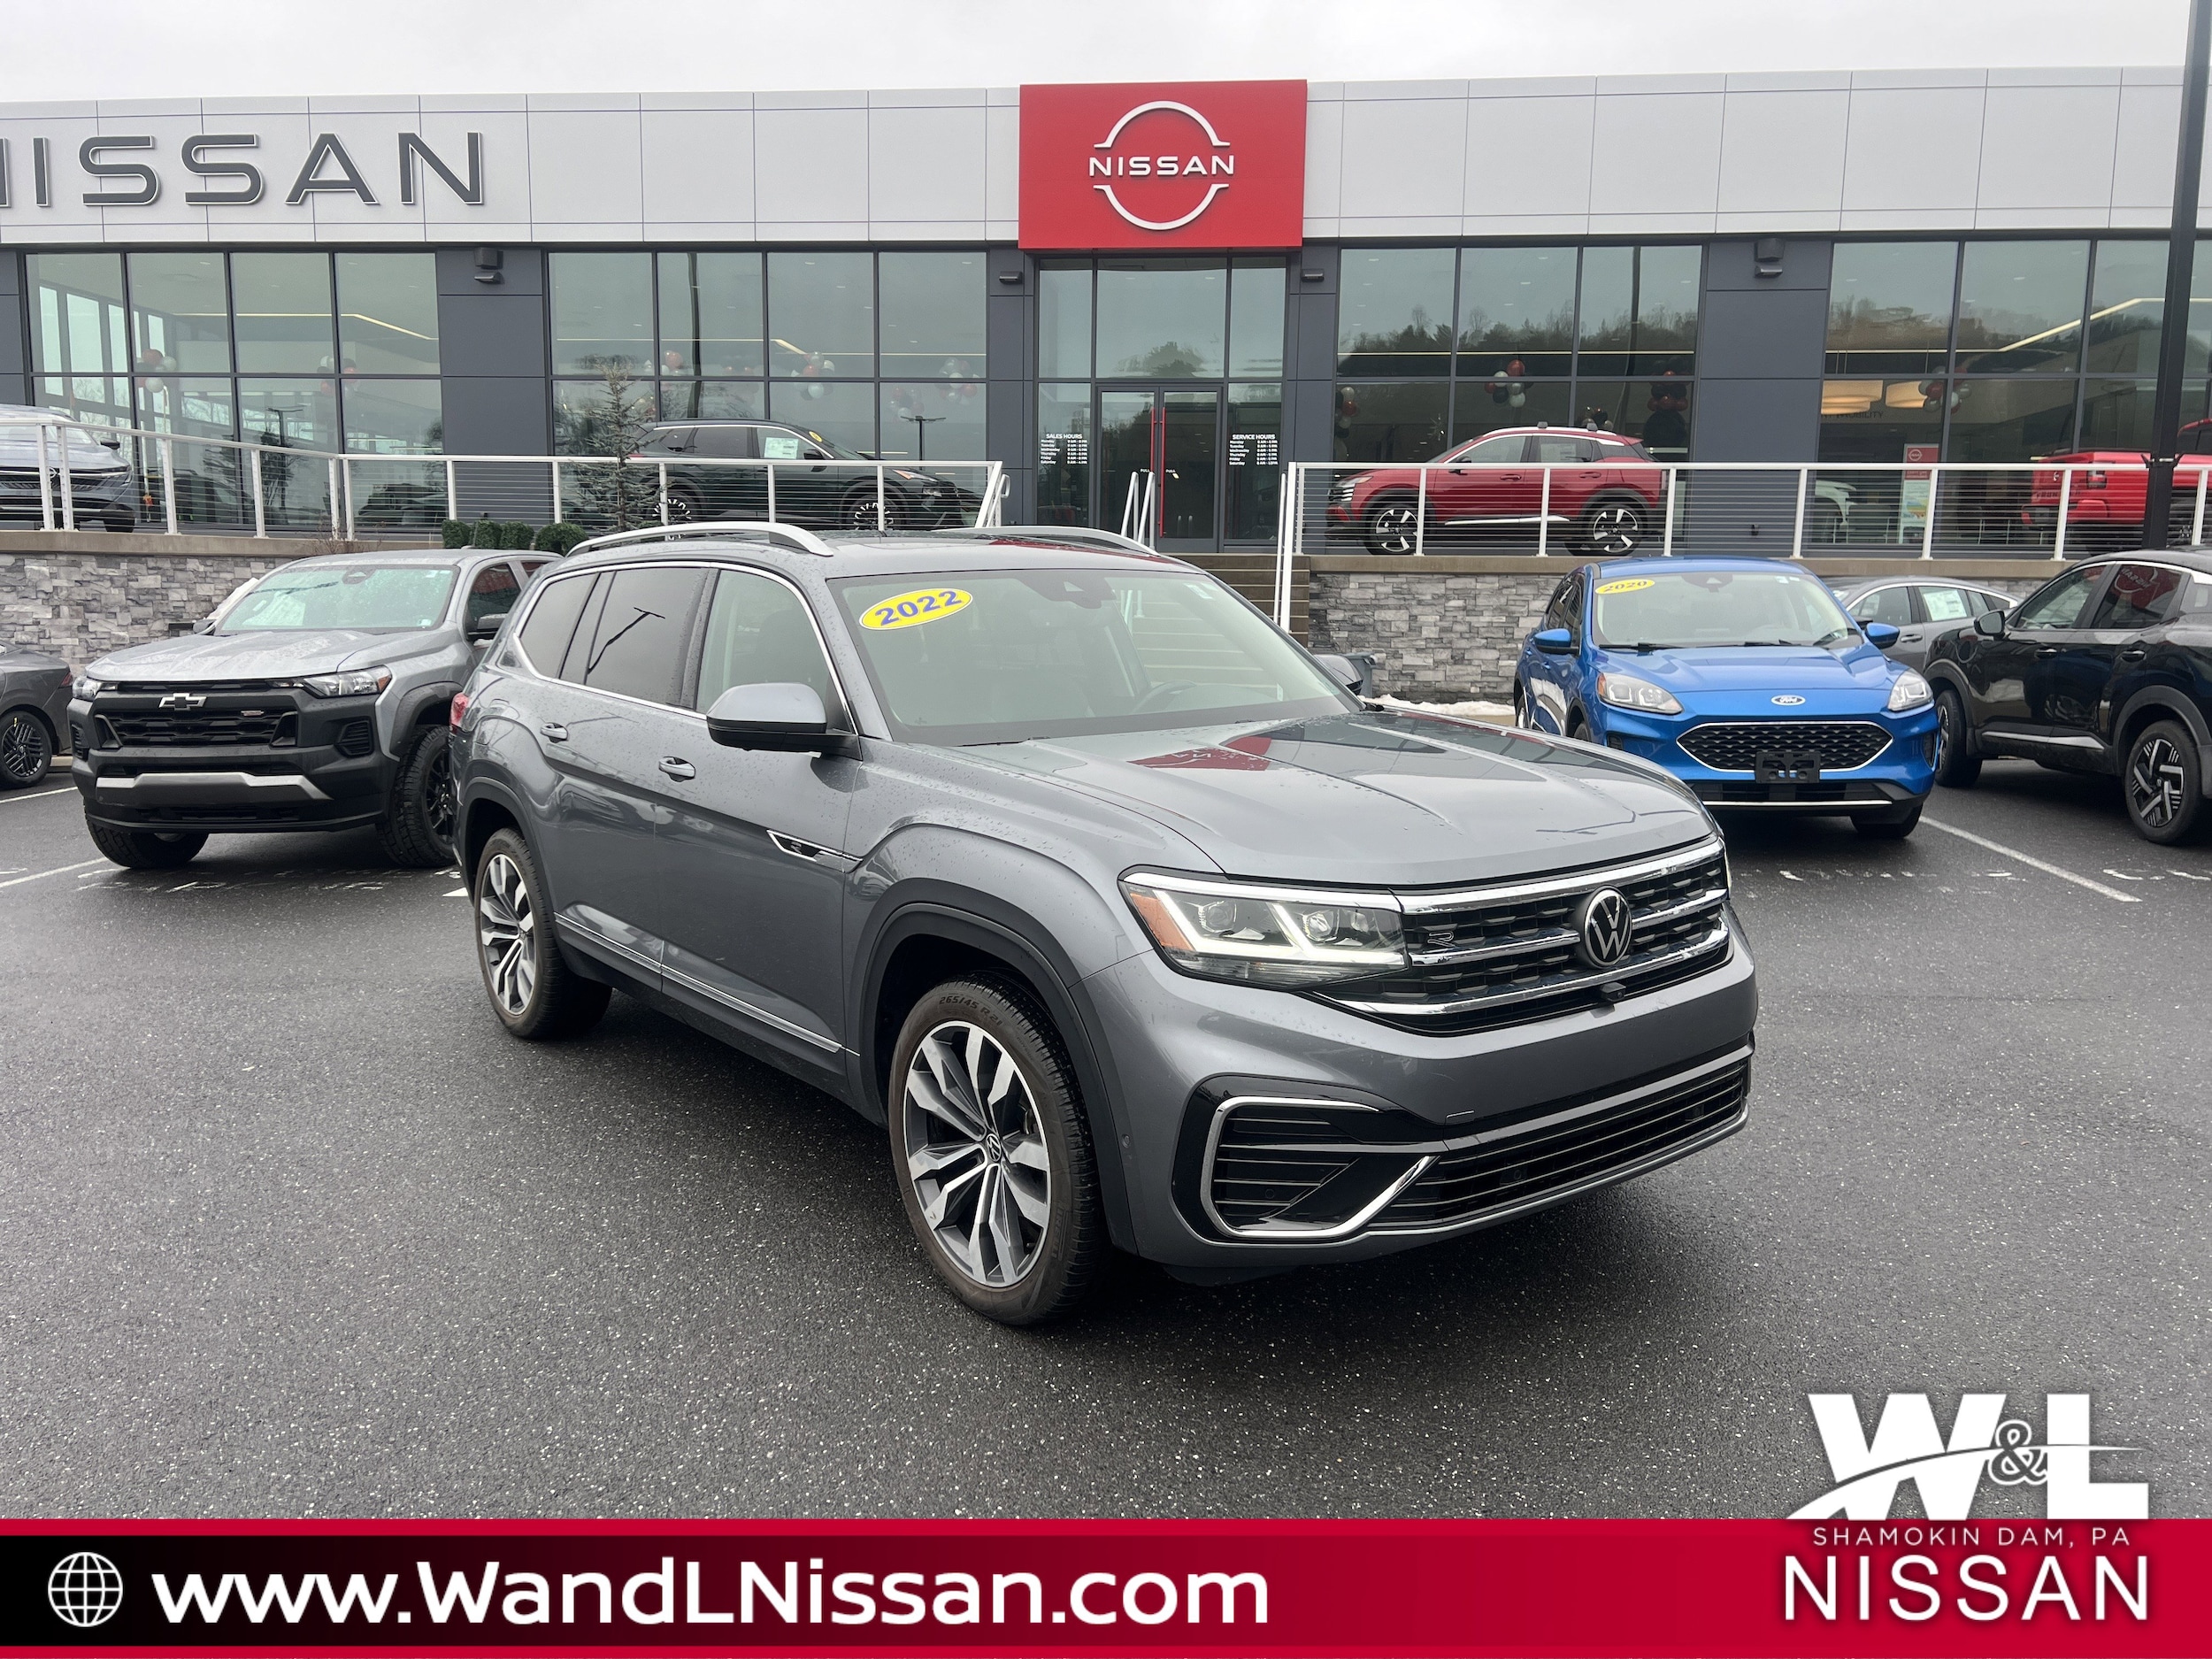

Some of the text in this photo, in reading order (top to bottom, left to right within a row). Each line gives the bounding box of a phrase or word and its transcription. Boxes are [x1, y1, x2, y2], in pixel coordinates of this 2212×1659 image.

[0, 132, 485, 207] ISSAN
[1089, 155, 1234, 177] NISSAN
[1603, 580, 1647, 592] 2020
[875, 590, 963, 626] 2022
[939, 995, 979, 1009] 265/45
[980, 1007, 991, 1016] R
